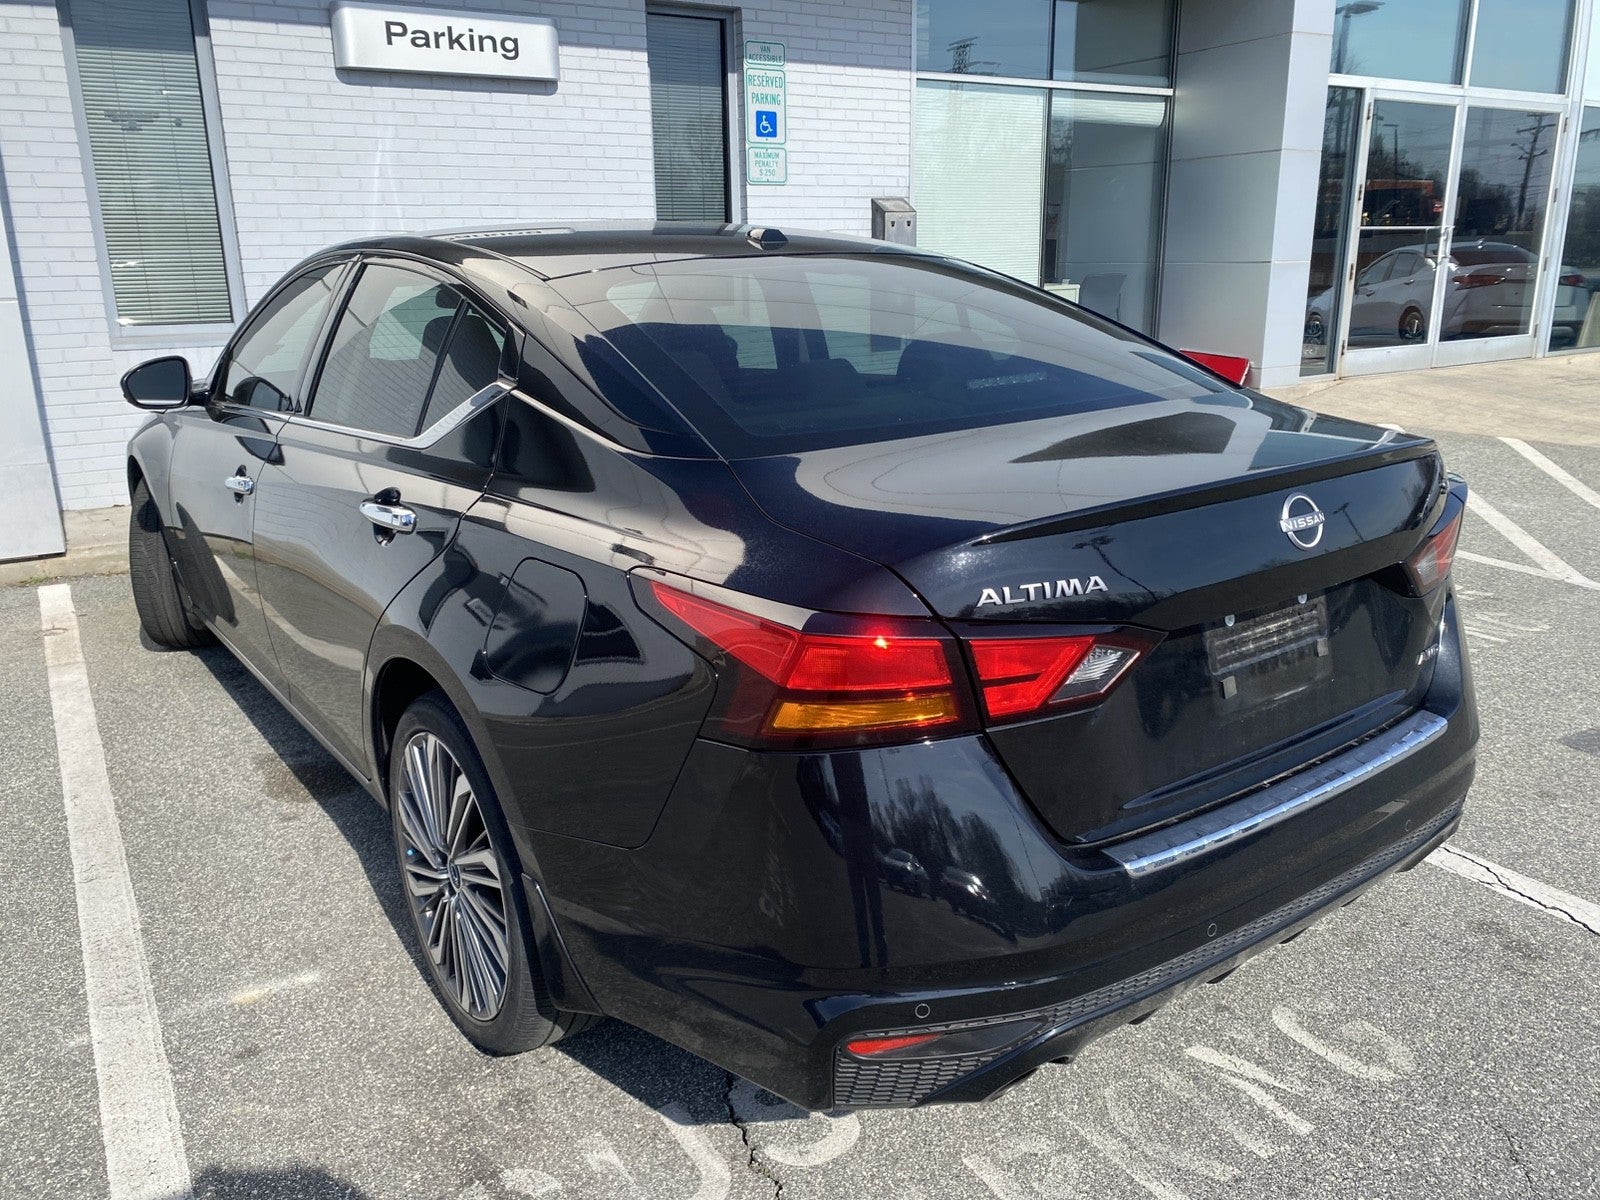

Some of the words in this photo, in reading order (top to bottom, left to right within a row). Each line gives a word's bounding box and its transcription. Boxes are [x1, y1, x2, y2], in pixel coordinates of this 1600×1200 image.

[384, 20, 519, 61] Parking
[760, 45, 771, 53] VAN
[748, 53, 783, 63] ACCESSIBLE
[748, 74, 784, 89] RESERVED
[751, 92, 781, 106] PARKING
[753, 151, 780, 159] MAXIMUM
[754, 159, 778, 168] PENALTY
[1280, 512, 1325, 532] NISSAN
[975, 575, 1109, 608] ALTIMA
